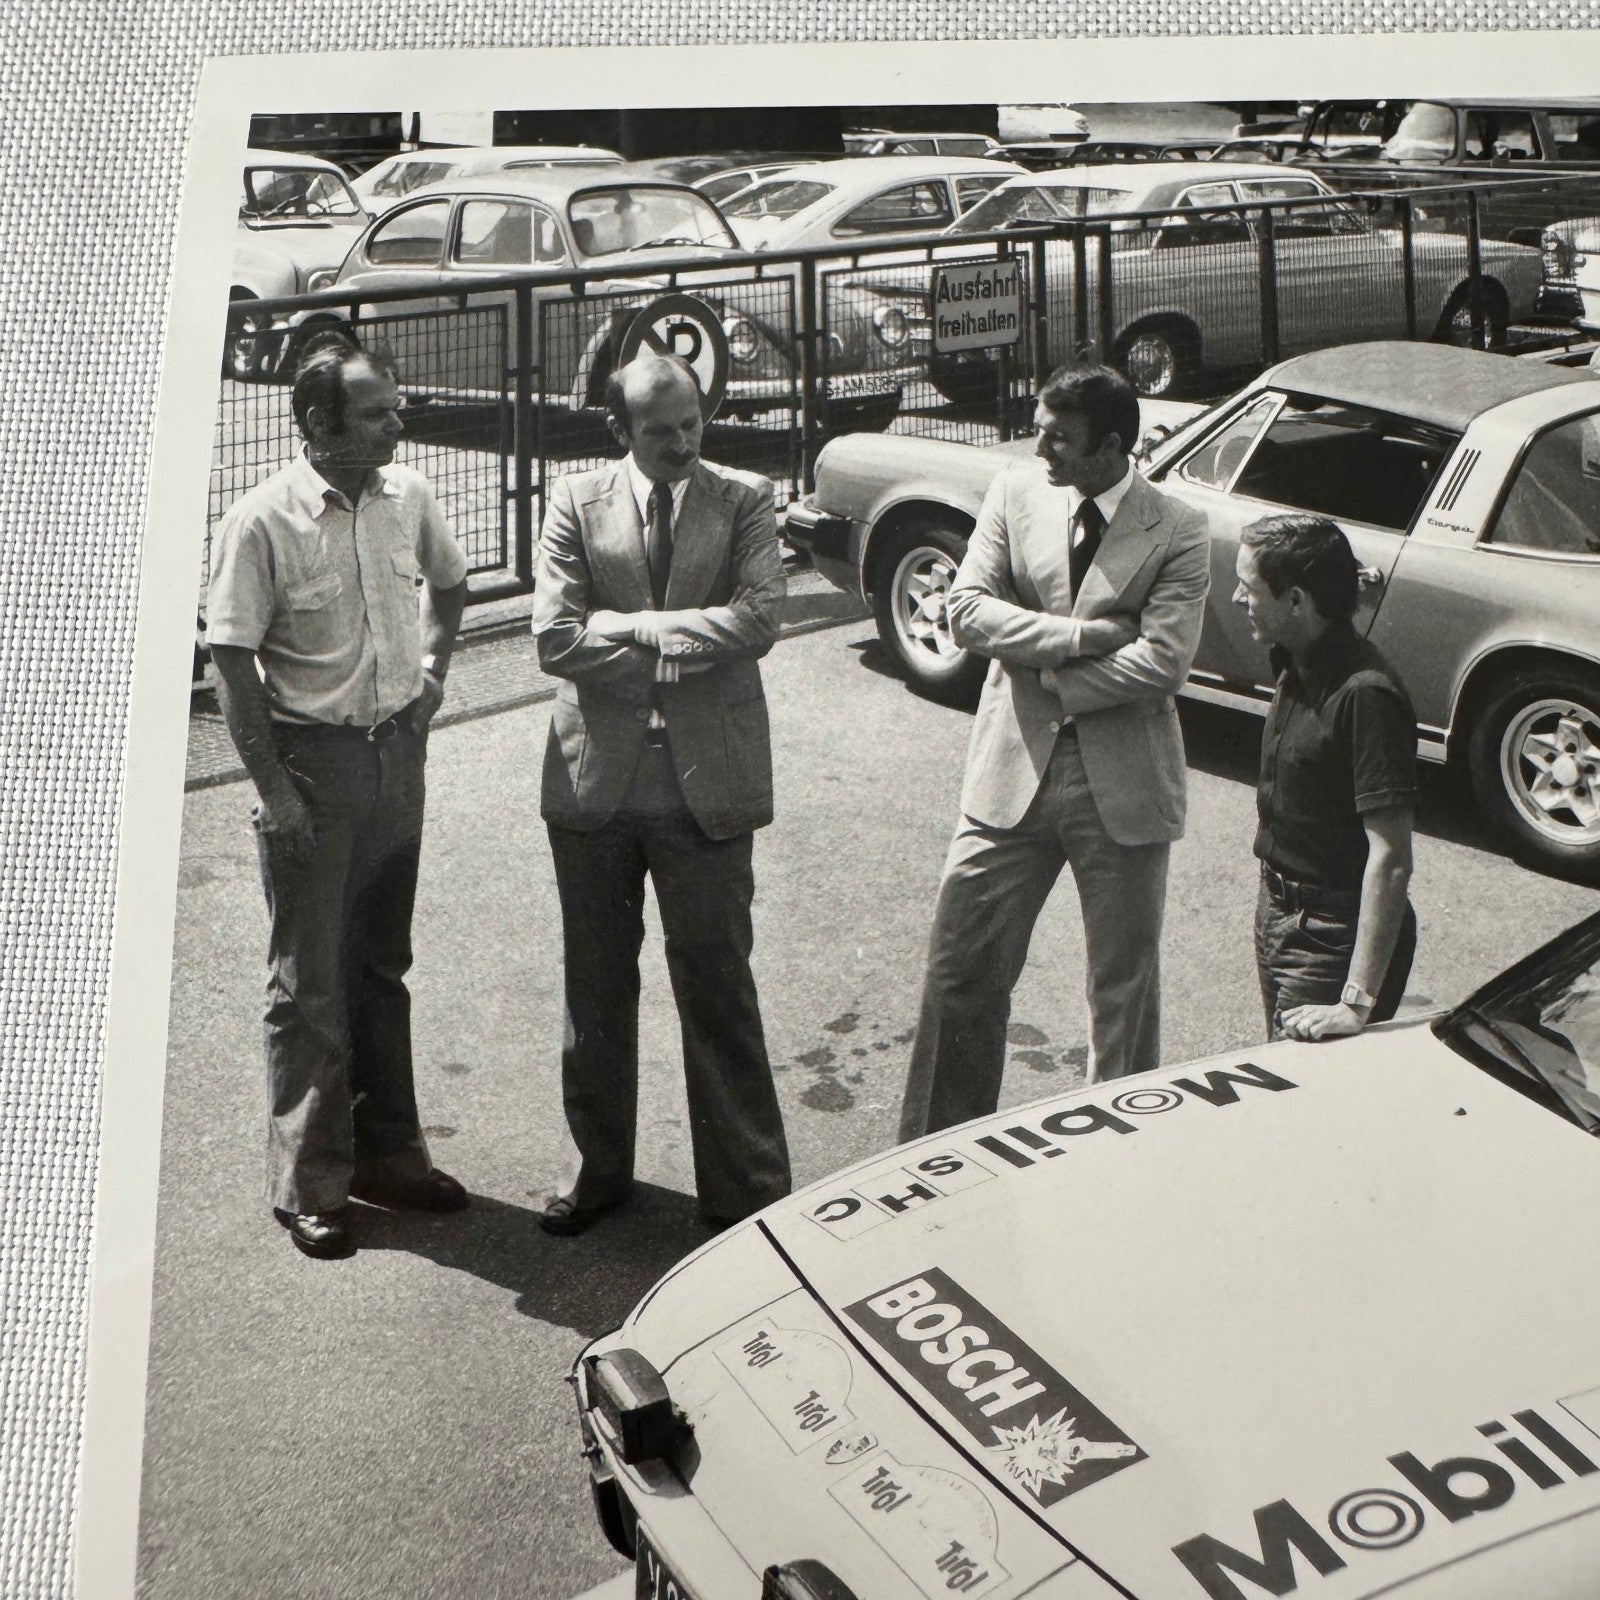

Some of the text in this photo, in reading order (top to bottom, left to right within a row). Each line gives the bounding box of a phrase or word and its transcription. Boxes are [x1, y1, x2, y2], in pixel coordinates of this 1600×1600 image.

[936, 266, 1017, 303] Ausfahrt
[938, 309, 1016, 339] freihalten
[813, 1062, 1299, 1223] Mobil SHC
[742, 1330, 784, 1369] Tirol
[866, 1277, 1047, 1418] BOSCH
[793, 1390, 838, 1432] Tirol
[861, 1466, 913, 1514] Tirol
[1171, 1408, 1600, 1600] Mobil
[934, 1539, 990, 1593] Tirol
